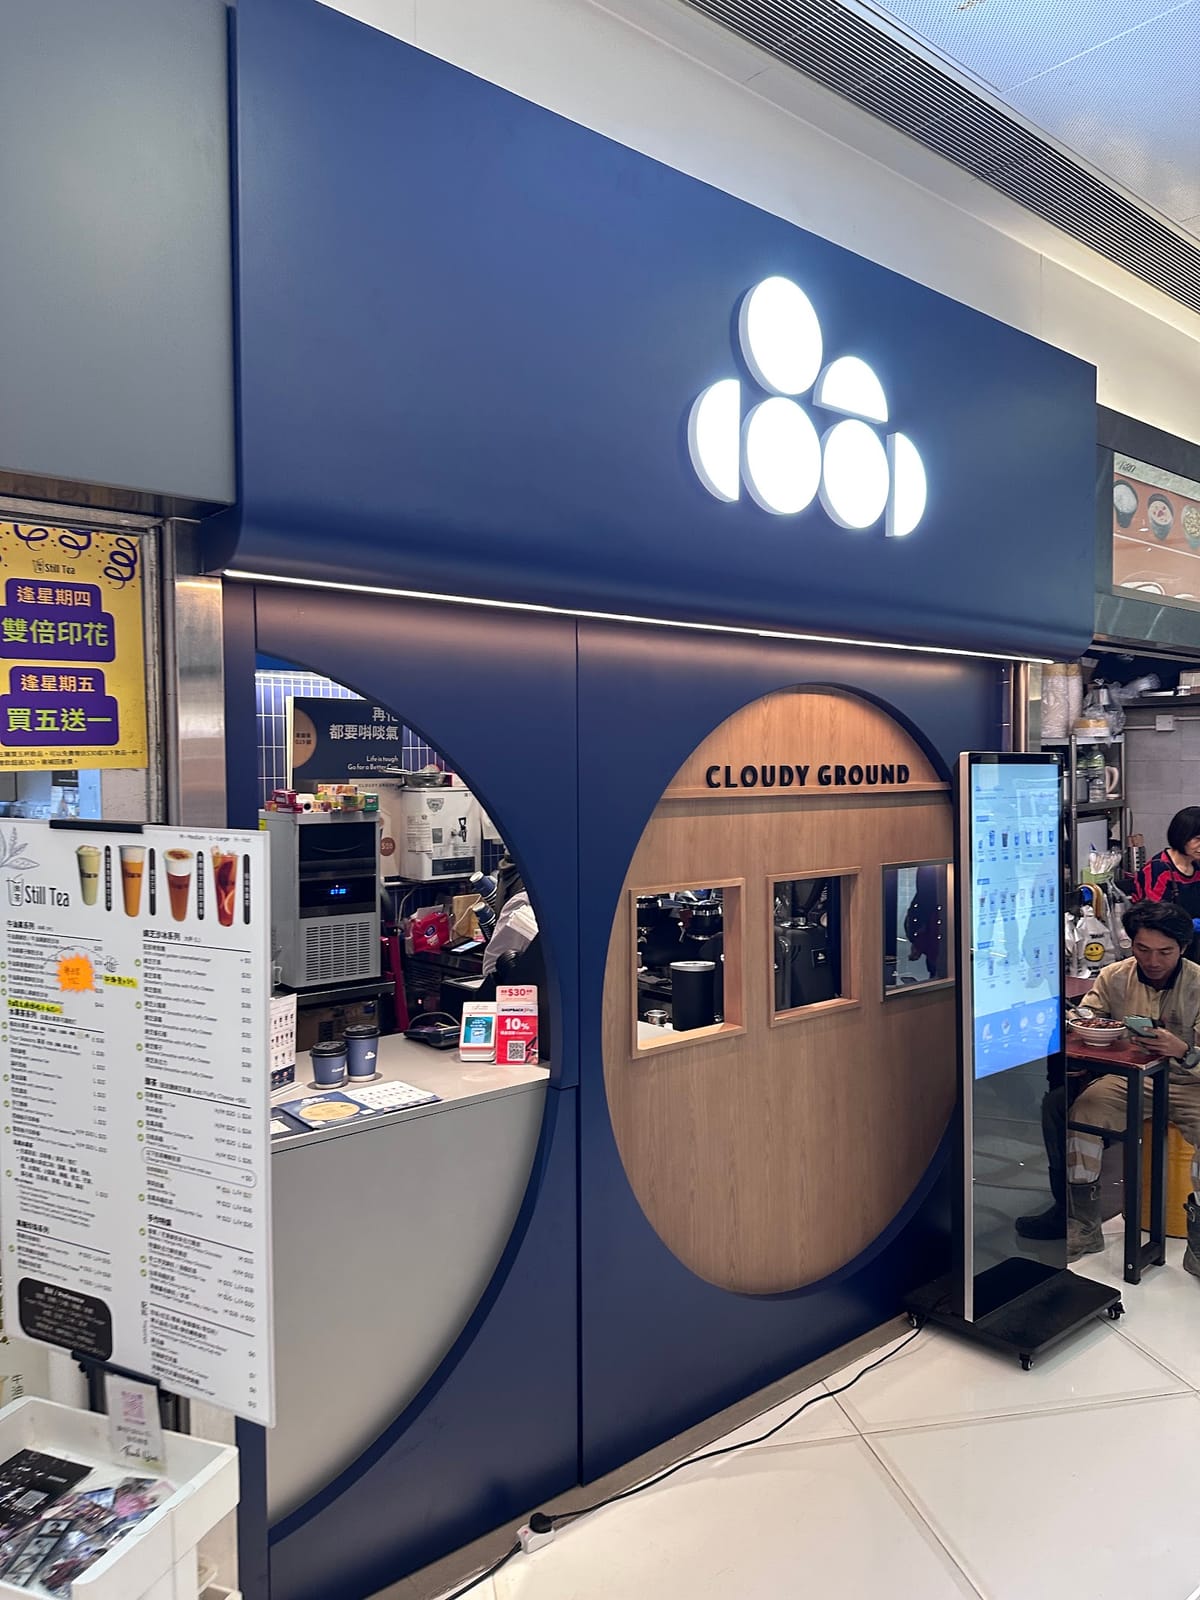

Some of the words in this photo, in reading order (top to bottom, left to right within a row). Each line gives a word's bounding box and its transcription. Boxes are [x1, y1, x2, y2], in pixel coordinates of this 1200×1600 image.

[16, 586, 91, 607] 逢星期四
[1, 618, 109, 647] 雙倍印花
[20, 674, 95, 693] 逢星期五
[6, 708, 112, 732] 買五送一
[356, 763, 365, 771] for
[366, 755, 378, 763] Life
[383, 756, 399, 764] tough
[706, 765, 810, 789] CLOUDY
[818, 763, 910, 787] GROUND
[24, 885, 46, 905] Still
[48, 887, 70, 907] Tea
[505, 1018, 530, 1030] 10%
